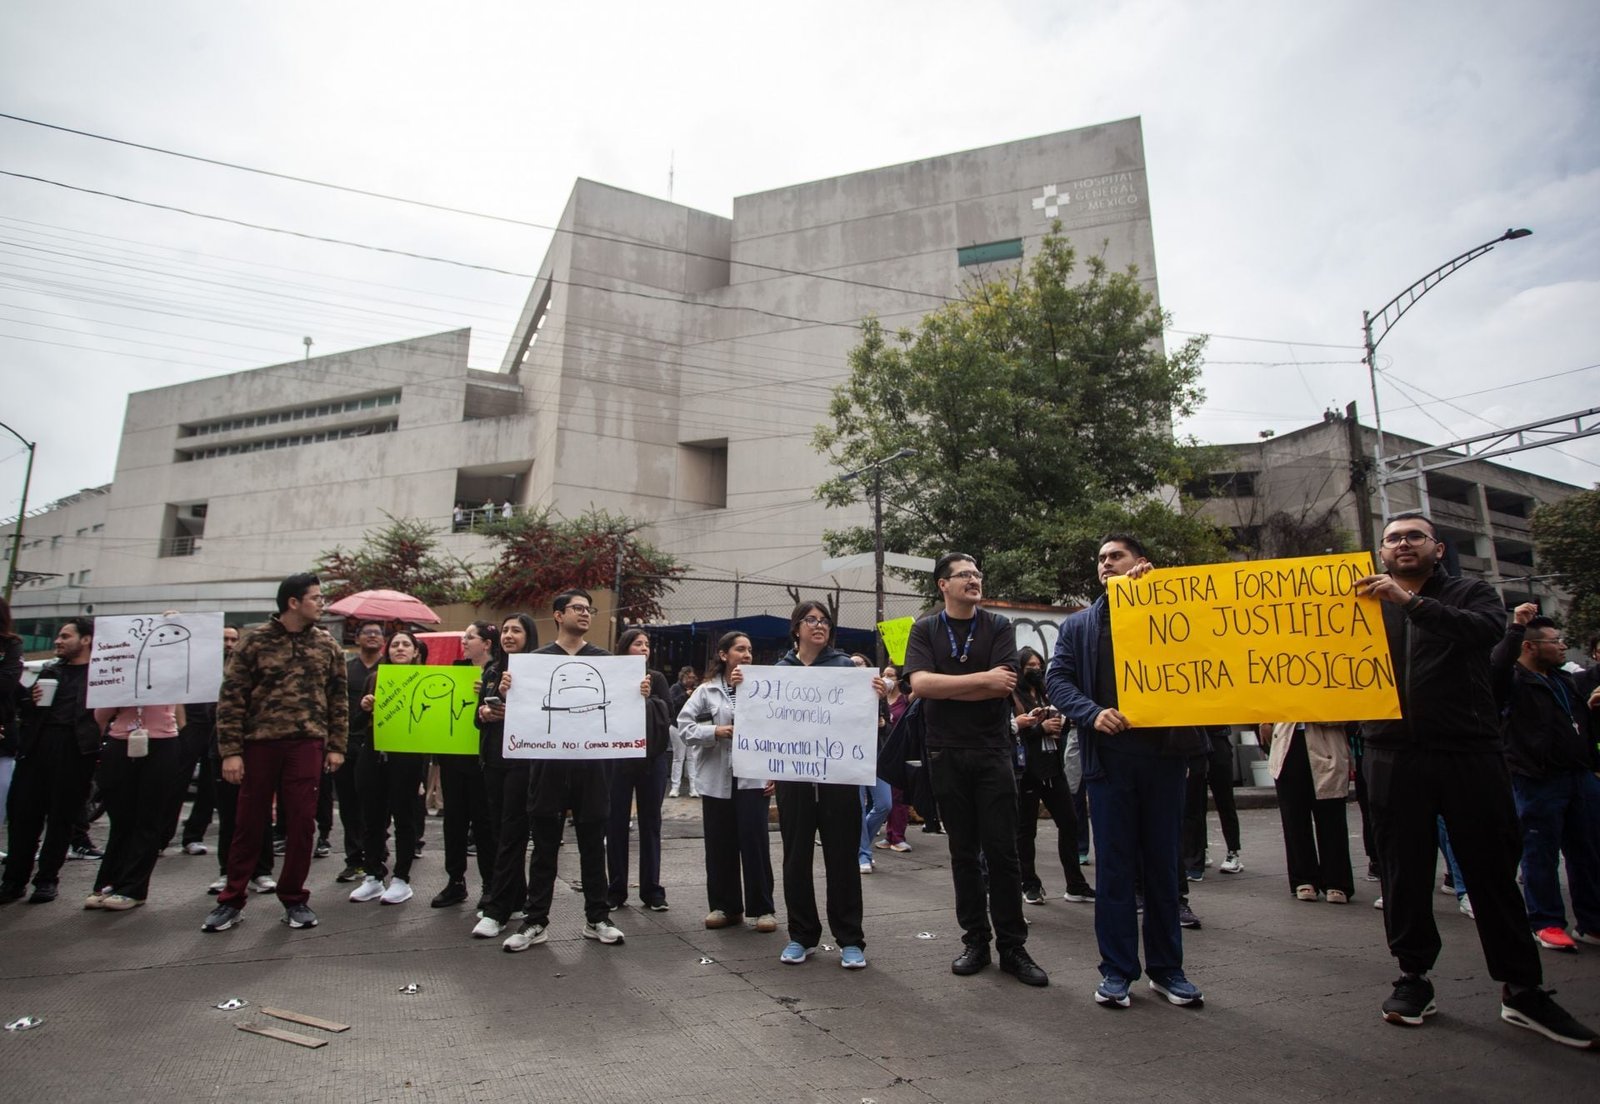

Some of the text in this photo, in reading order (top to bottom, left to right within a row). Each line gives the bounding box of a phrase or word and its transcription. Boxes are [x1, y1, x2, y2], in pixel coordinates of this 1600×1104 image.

[1075, 184, 1136, 201] GENERAL
[1115, 559, 1371, 608] NUESTRA FORMACIÓN
[1149, 601, 1373, 645] NO JUSTIFICA
[1123, 645, 1395, 694] NUESTRA EXPOSICIÓN
[785, 680, 821, 703] Casos
[828, 686, 844, 705] de
[767, 701, 831, 725] Salmonella
[508, 735, 557, 751] Salmonella
[738, 734, 864, 760] la salmonella NO es
[768, 758, 827, 780] un virus!
